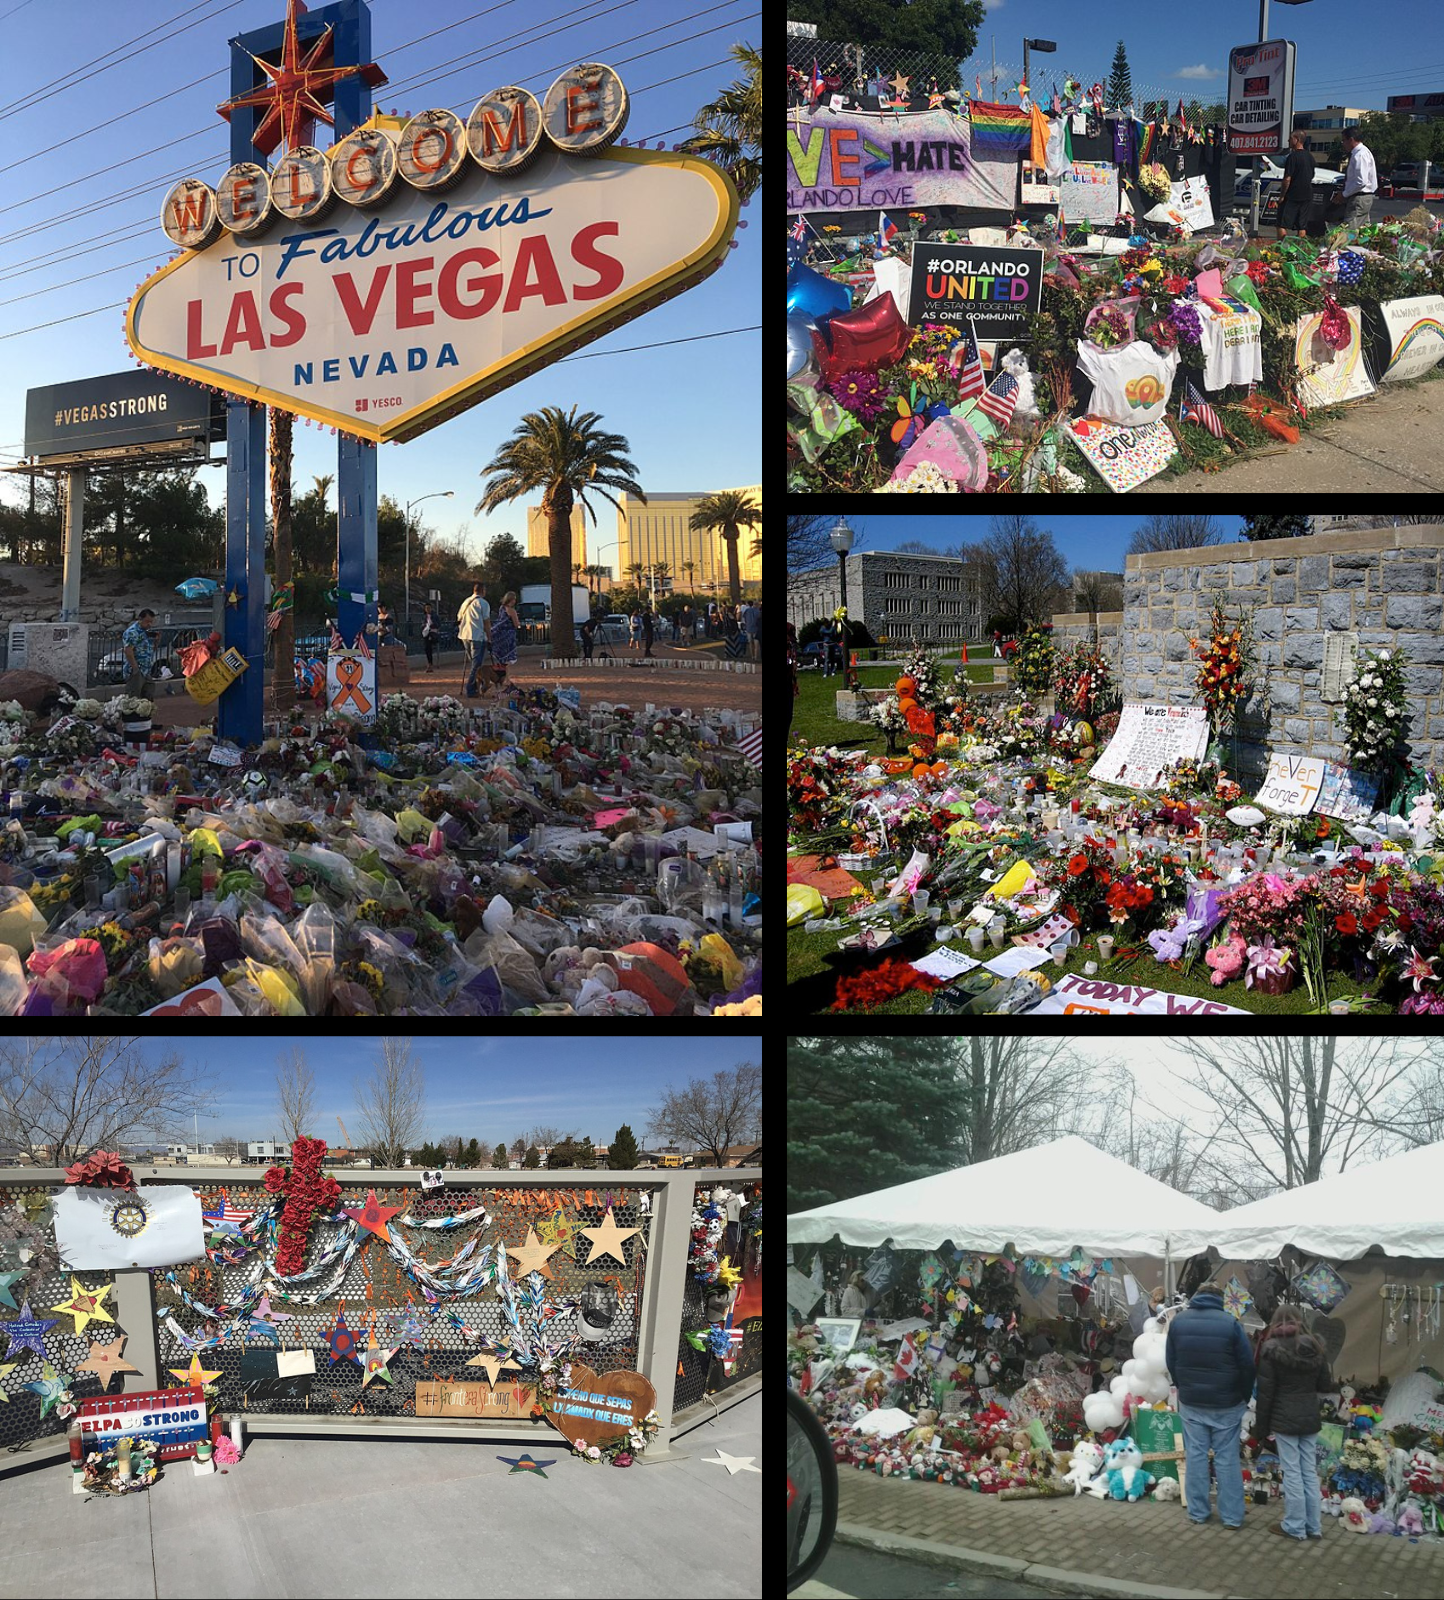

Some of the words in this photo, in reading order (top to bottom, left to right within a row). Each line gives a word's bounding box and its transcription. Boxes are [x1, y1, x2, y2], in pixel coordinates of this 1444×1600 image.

[1235, 101, 1248, 112] CAR
[1249, 98, 1276, 111] TINTING
[1231, 113, 1244, 125] CAR
[1245, 110, 1280, 123] DETAILING
[1230, 135, 1279, 149] 407.841.2123
[171, 77, 602, 235] WELCOME
[892, 140, 965, 172] HATE
[222, 256, 259, 281] TO
[277, 197, 552, 280] Fabulous
[927, 259, 1030, 277] #ORLANDO
[186, 282, 305, 361] LAS
[332, 221, 625, 336] VEGAS
[926, 274, 1030, 301] UNITED
[924, 301, 941, 309] WE
[943, 301, 975, 310] STAND
[978, 302, 1028, 311] TOGETHER
[921, 312, 936, 320] AS
[940, 312, 963, 320] ONE
[966, 312, 1027, 321] COMMUNITY
[293, 342, 459, 386] NEVADA
[372, 396, 402, 409] YESCO
[1061, 975, 1158, 1007] TODAY
[589, 1392, 606, 1405] QUE
[606, 1395, 633, 1410] SEPAS
[595, 1409, 611, 1423] QUE
[611, 1411, 634, 1427] ERES
[1427, 1408, 1444, 1417] ME
